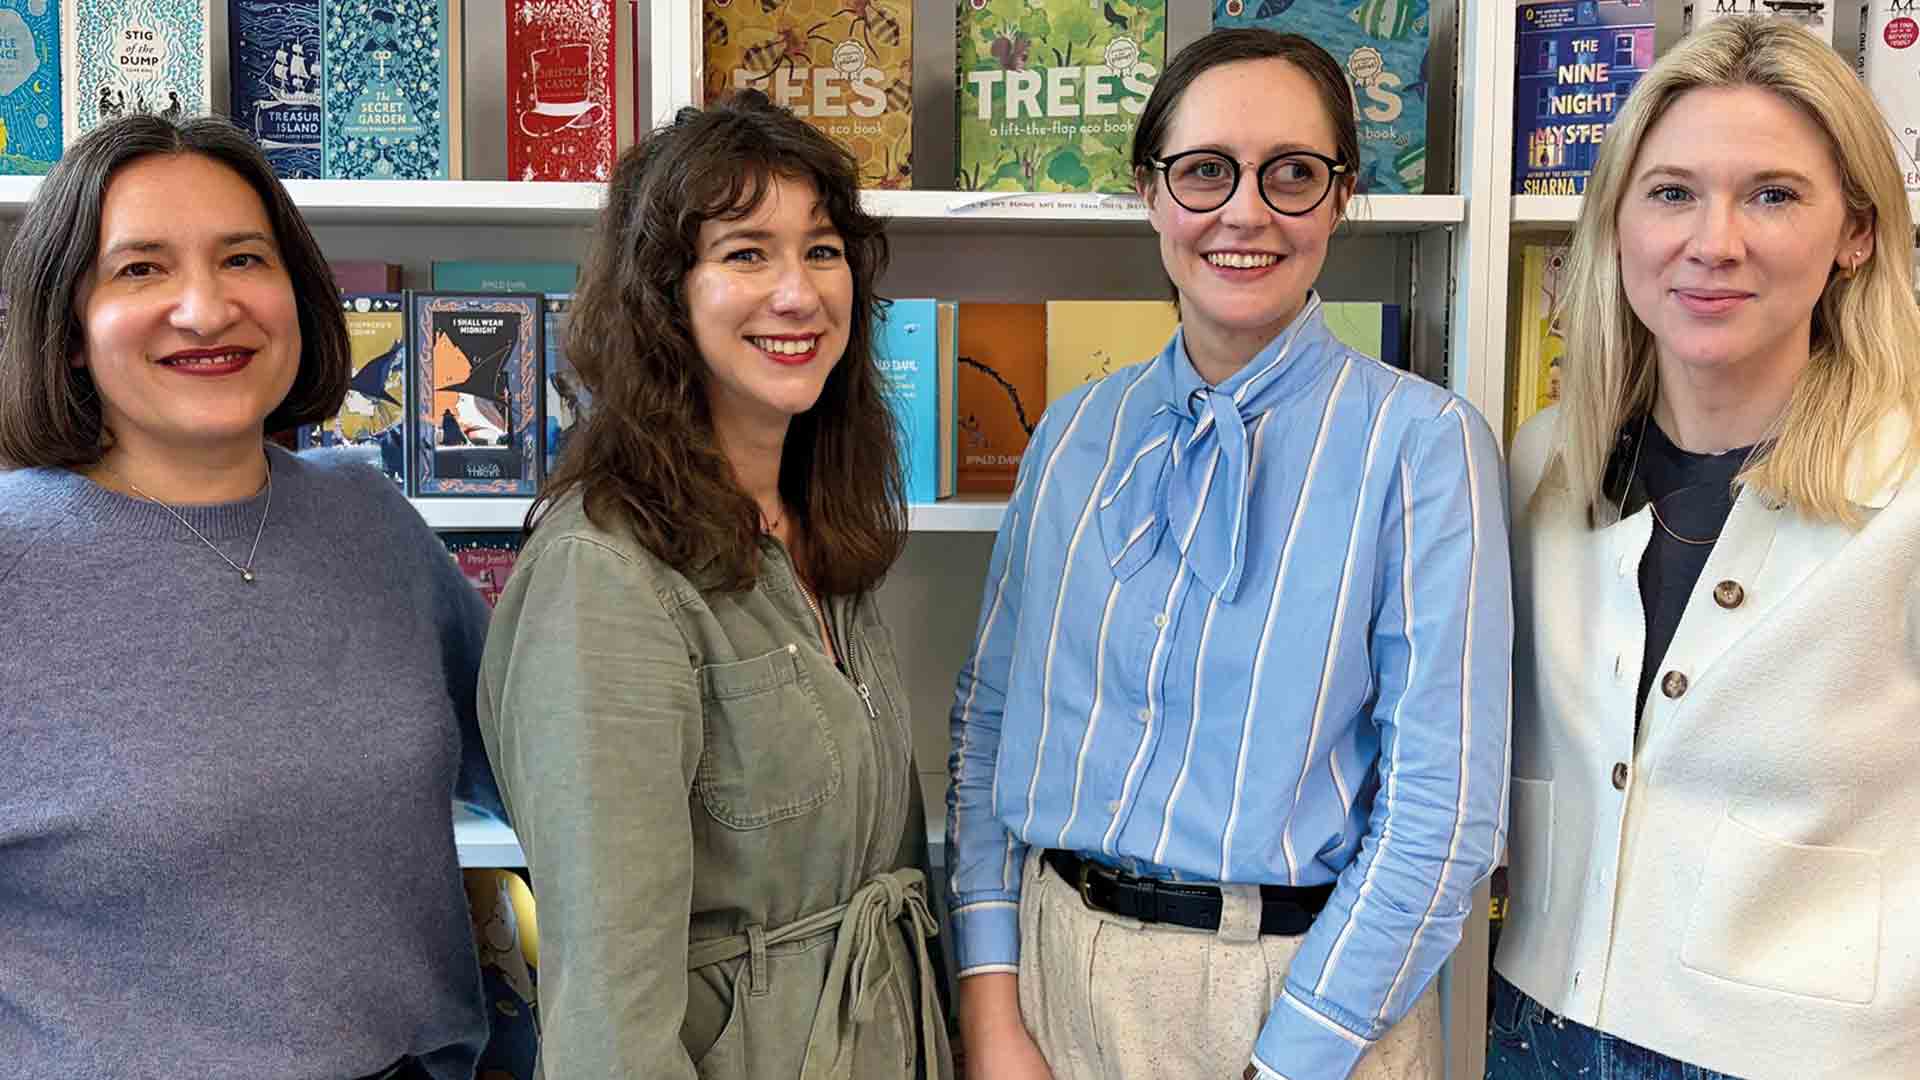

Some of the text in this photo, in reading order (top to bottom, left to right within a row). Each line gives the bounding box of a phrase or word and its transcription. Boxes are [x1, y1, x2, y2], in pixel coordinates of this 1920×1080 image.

[125, 31, 153, 40] STIG
[1571, 40, 1599, 53] THE
[120, 56, 159, 66] DUMP
[1558, 63, 1609, 85] NINE
[968, 63, 1156, 119] TREES
[361, 102, 403, 113] SECRET
[1552, 92, 1616, 114] NIGHT
[269, 112, 320, 121] TREASUR
[359, 114, 407, 125] GARDEN
[276, 122, 319, 133] ISLAND
[832, 126, 848, 136] eco
[854, 120, 881, 136] book
[989, 119, 1134, 140] a lift-the-flap eco book
[1524, 177, 1576, 195] SHARNA
[453, 318, 504, 327] I SHALL WEAR
[460, 326, 497, 335] MIDNIGHT
